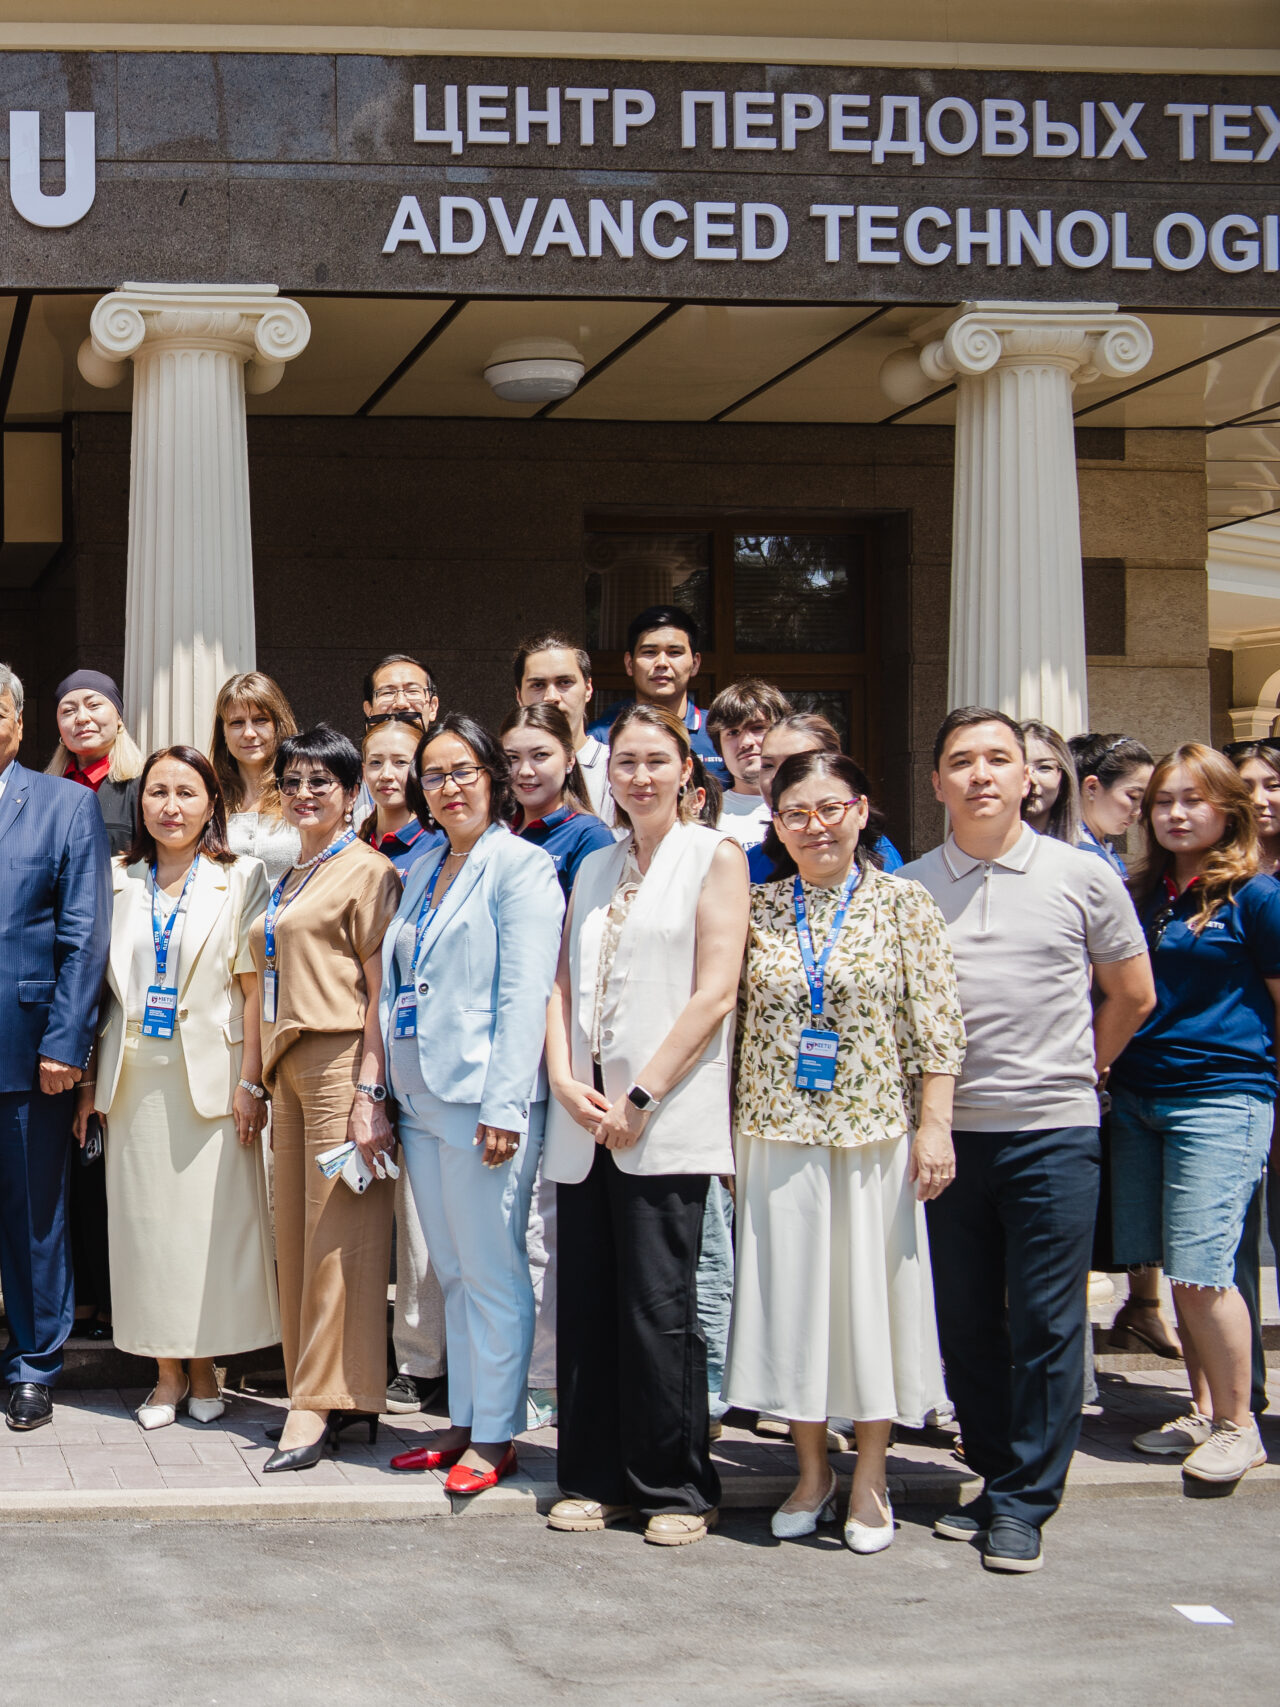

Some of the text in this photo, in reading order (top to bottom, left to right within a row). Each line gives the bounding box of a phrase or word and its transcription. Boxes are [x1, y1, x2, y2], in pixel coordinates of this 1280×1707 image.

[412, 84, 656, 155] ЦЕНТР
[680, 90, 1148, 165] ПЕРЕДОВЫХ
[381, 195, 1279, 274] ADVANCED TECHNOLOGI
